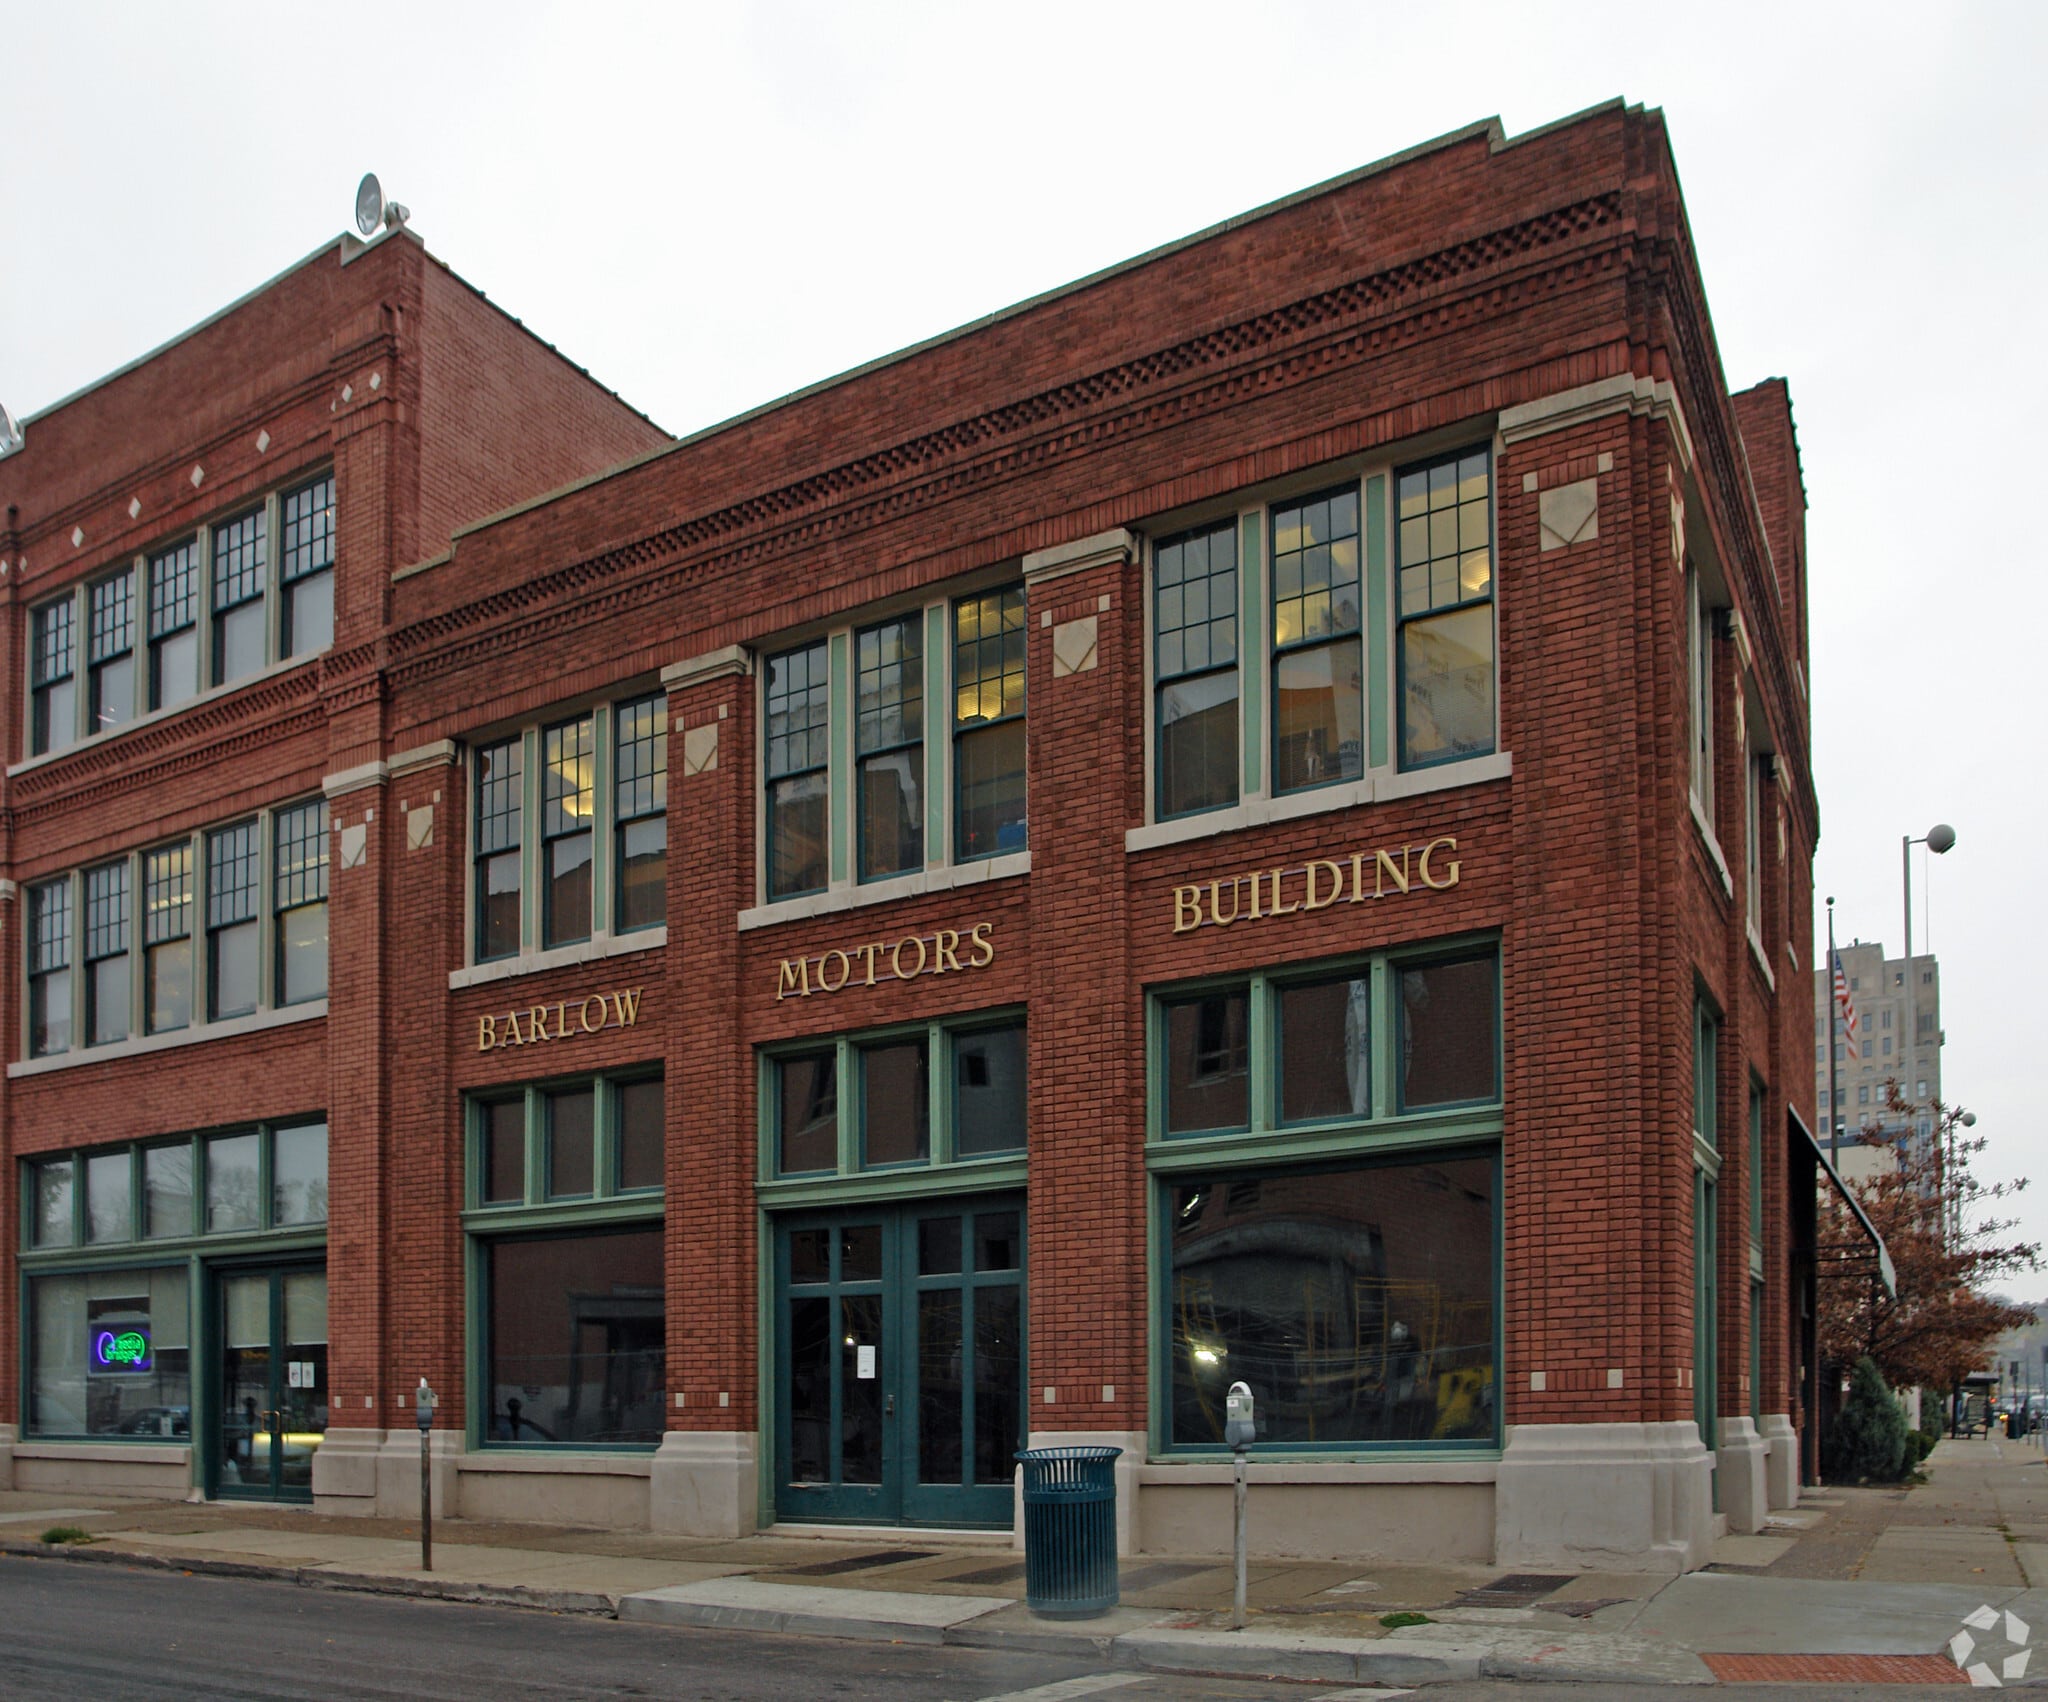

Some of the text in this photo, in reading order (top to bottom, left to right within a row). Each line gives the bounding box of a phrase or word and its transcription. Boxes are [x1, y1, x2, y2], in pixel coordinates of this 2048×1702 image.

[478, 837, 1463, 1052] BARLOW MOTORS BUILDING
